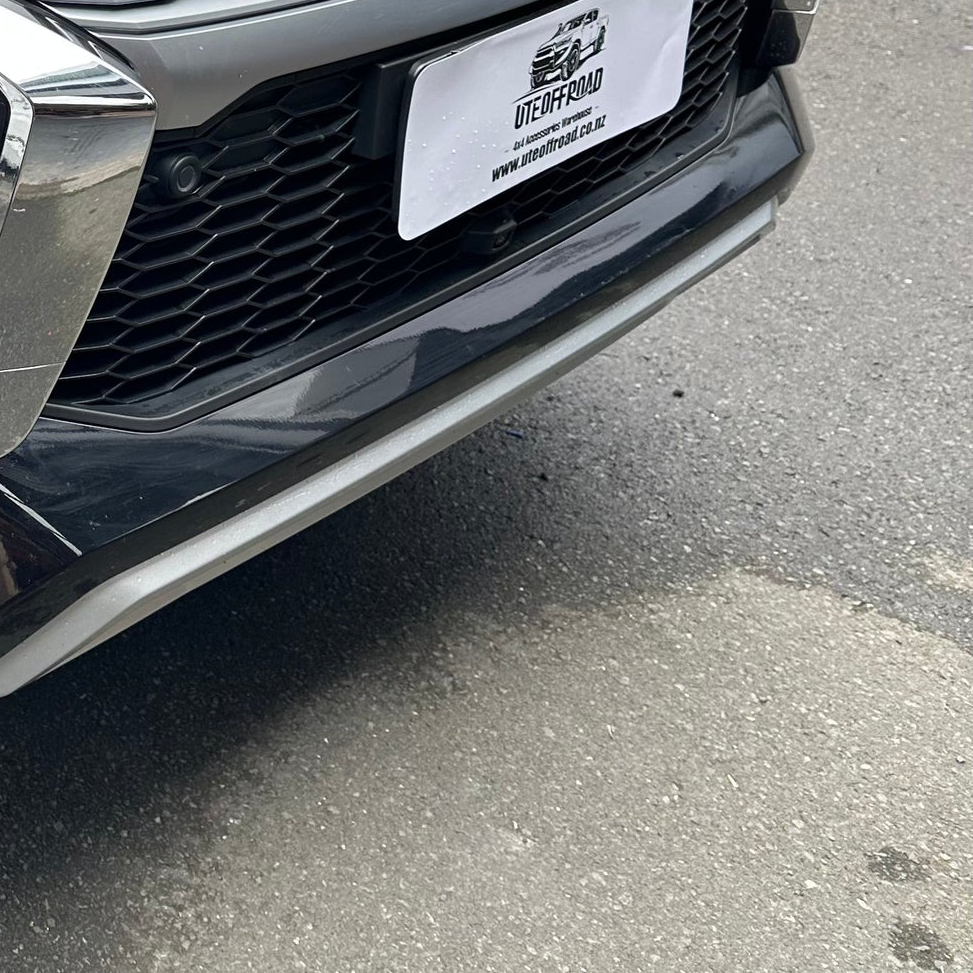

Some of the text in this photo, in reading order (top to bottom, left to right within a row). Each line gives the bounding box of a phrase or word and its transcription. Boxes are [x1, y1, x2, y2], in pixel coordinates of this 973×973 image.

[514, 68, 604, 129] UTEOFFROAD
[492, 114, 606, 182] www.uteoffroad.co.nz
[513, 138, 525, 151] 4x4
[527, 122, 561, 144] Accessories
